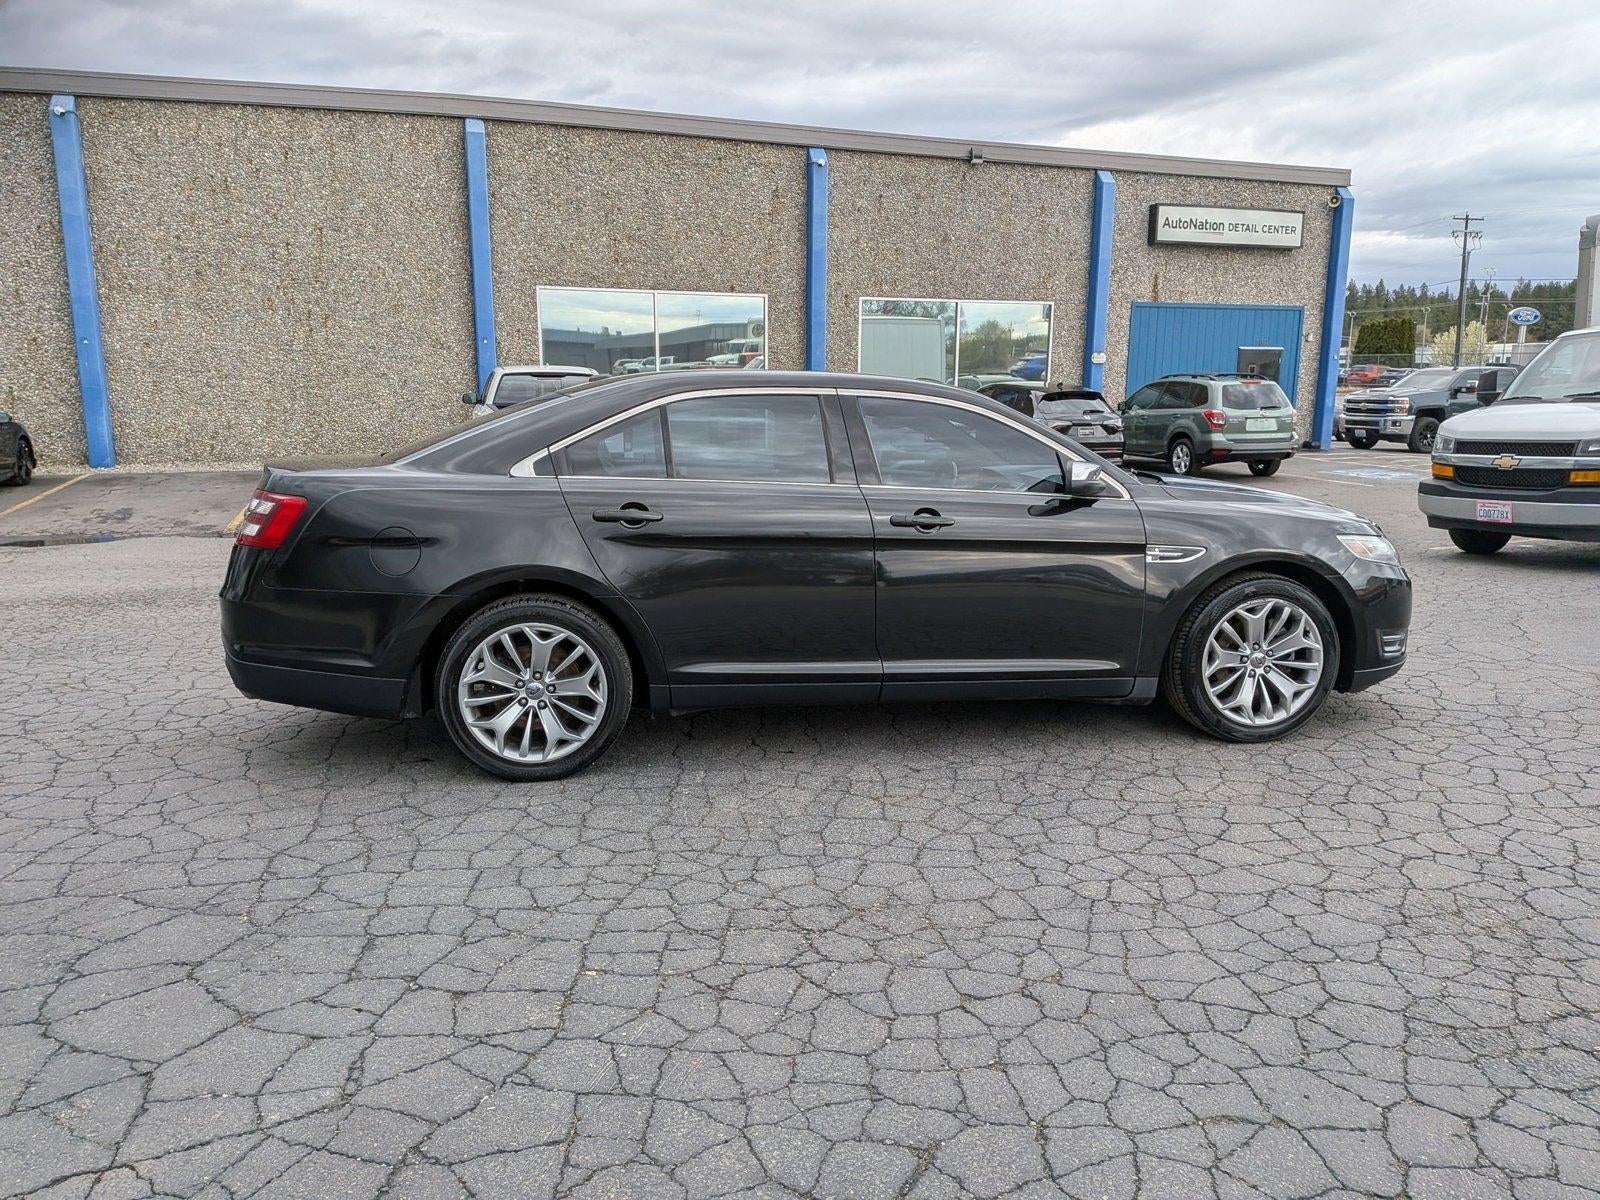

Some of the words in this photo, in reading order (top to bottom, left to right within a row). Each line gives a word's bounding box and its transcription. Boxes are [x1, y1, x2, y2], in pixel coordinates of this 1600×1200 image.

[1162, 216, 1225, 231] AutoNation
[1228, 222, 1259, 233] DETAIL
[1261, 224, 1297, 235] CENTER
[1517, 310, 1536, 321] Ford
